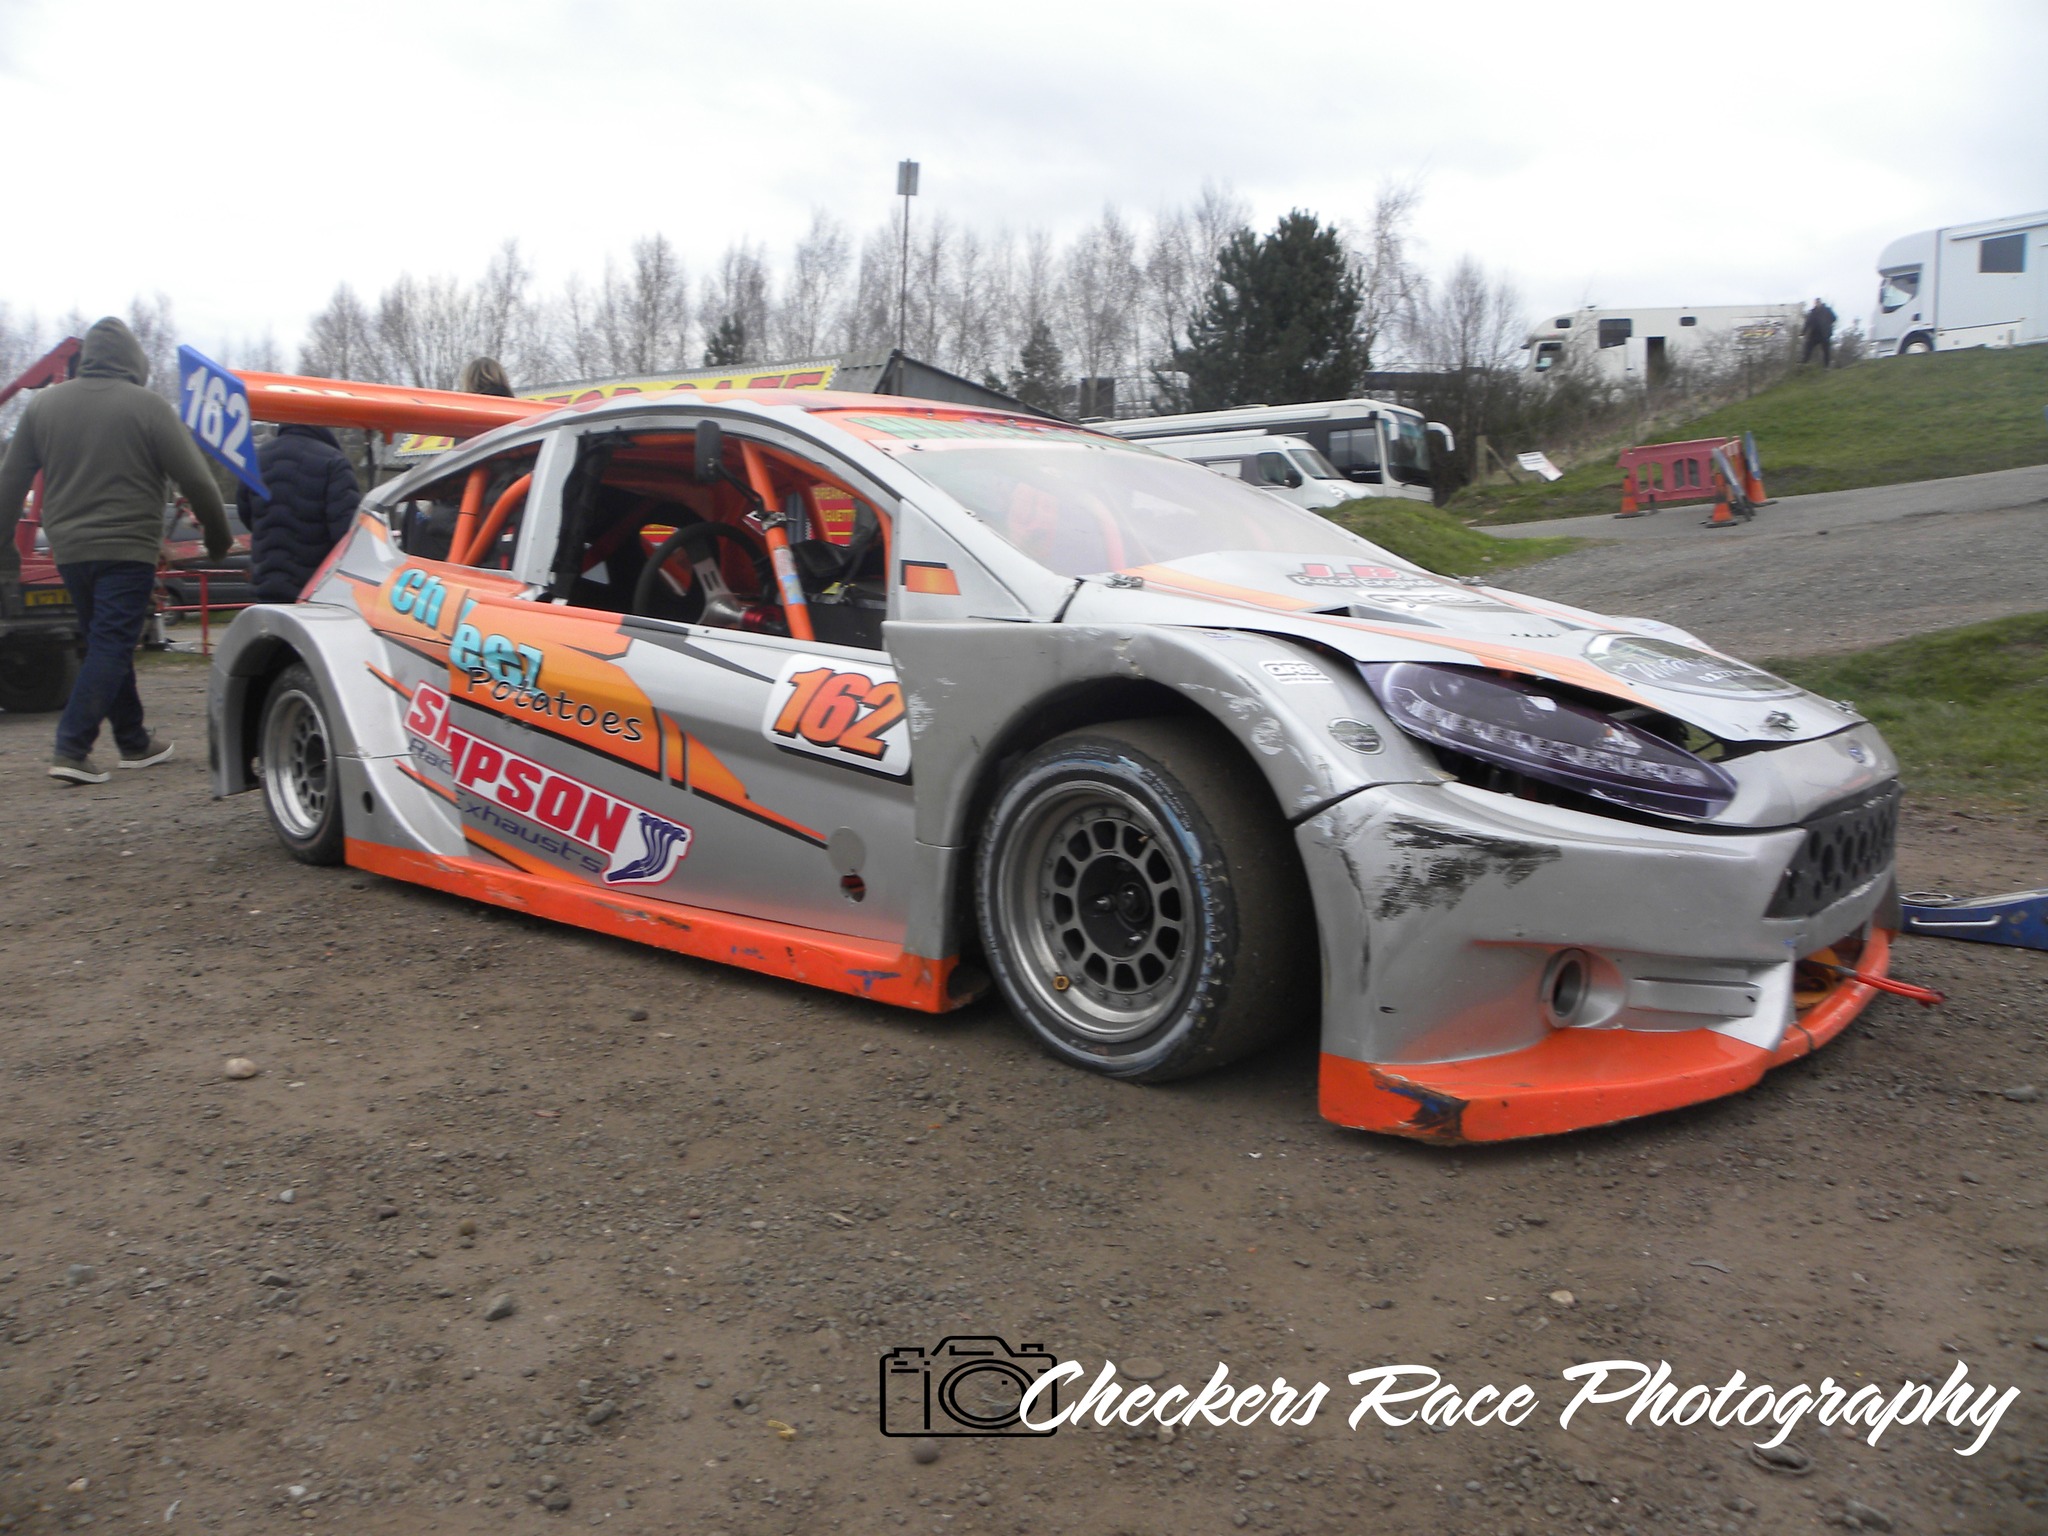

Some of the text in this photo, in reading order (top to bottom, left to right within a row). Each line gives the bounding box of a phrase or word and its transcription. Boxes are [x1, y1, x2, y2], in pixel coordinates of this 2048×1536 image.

[186, 366, 247, 468] 162
[467, 665, 644, 742] Potatoes
[772, 667, 907, 761] 162
